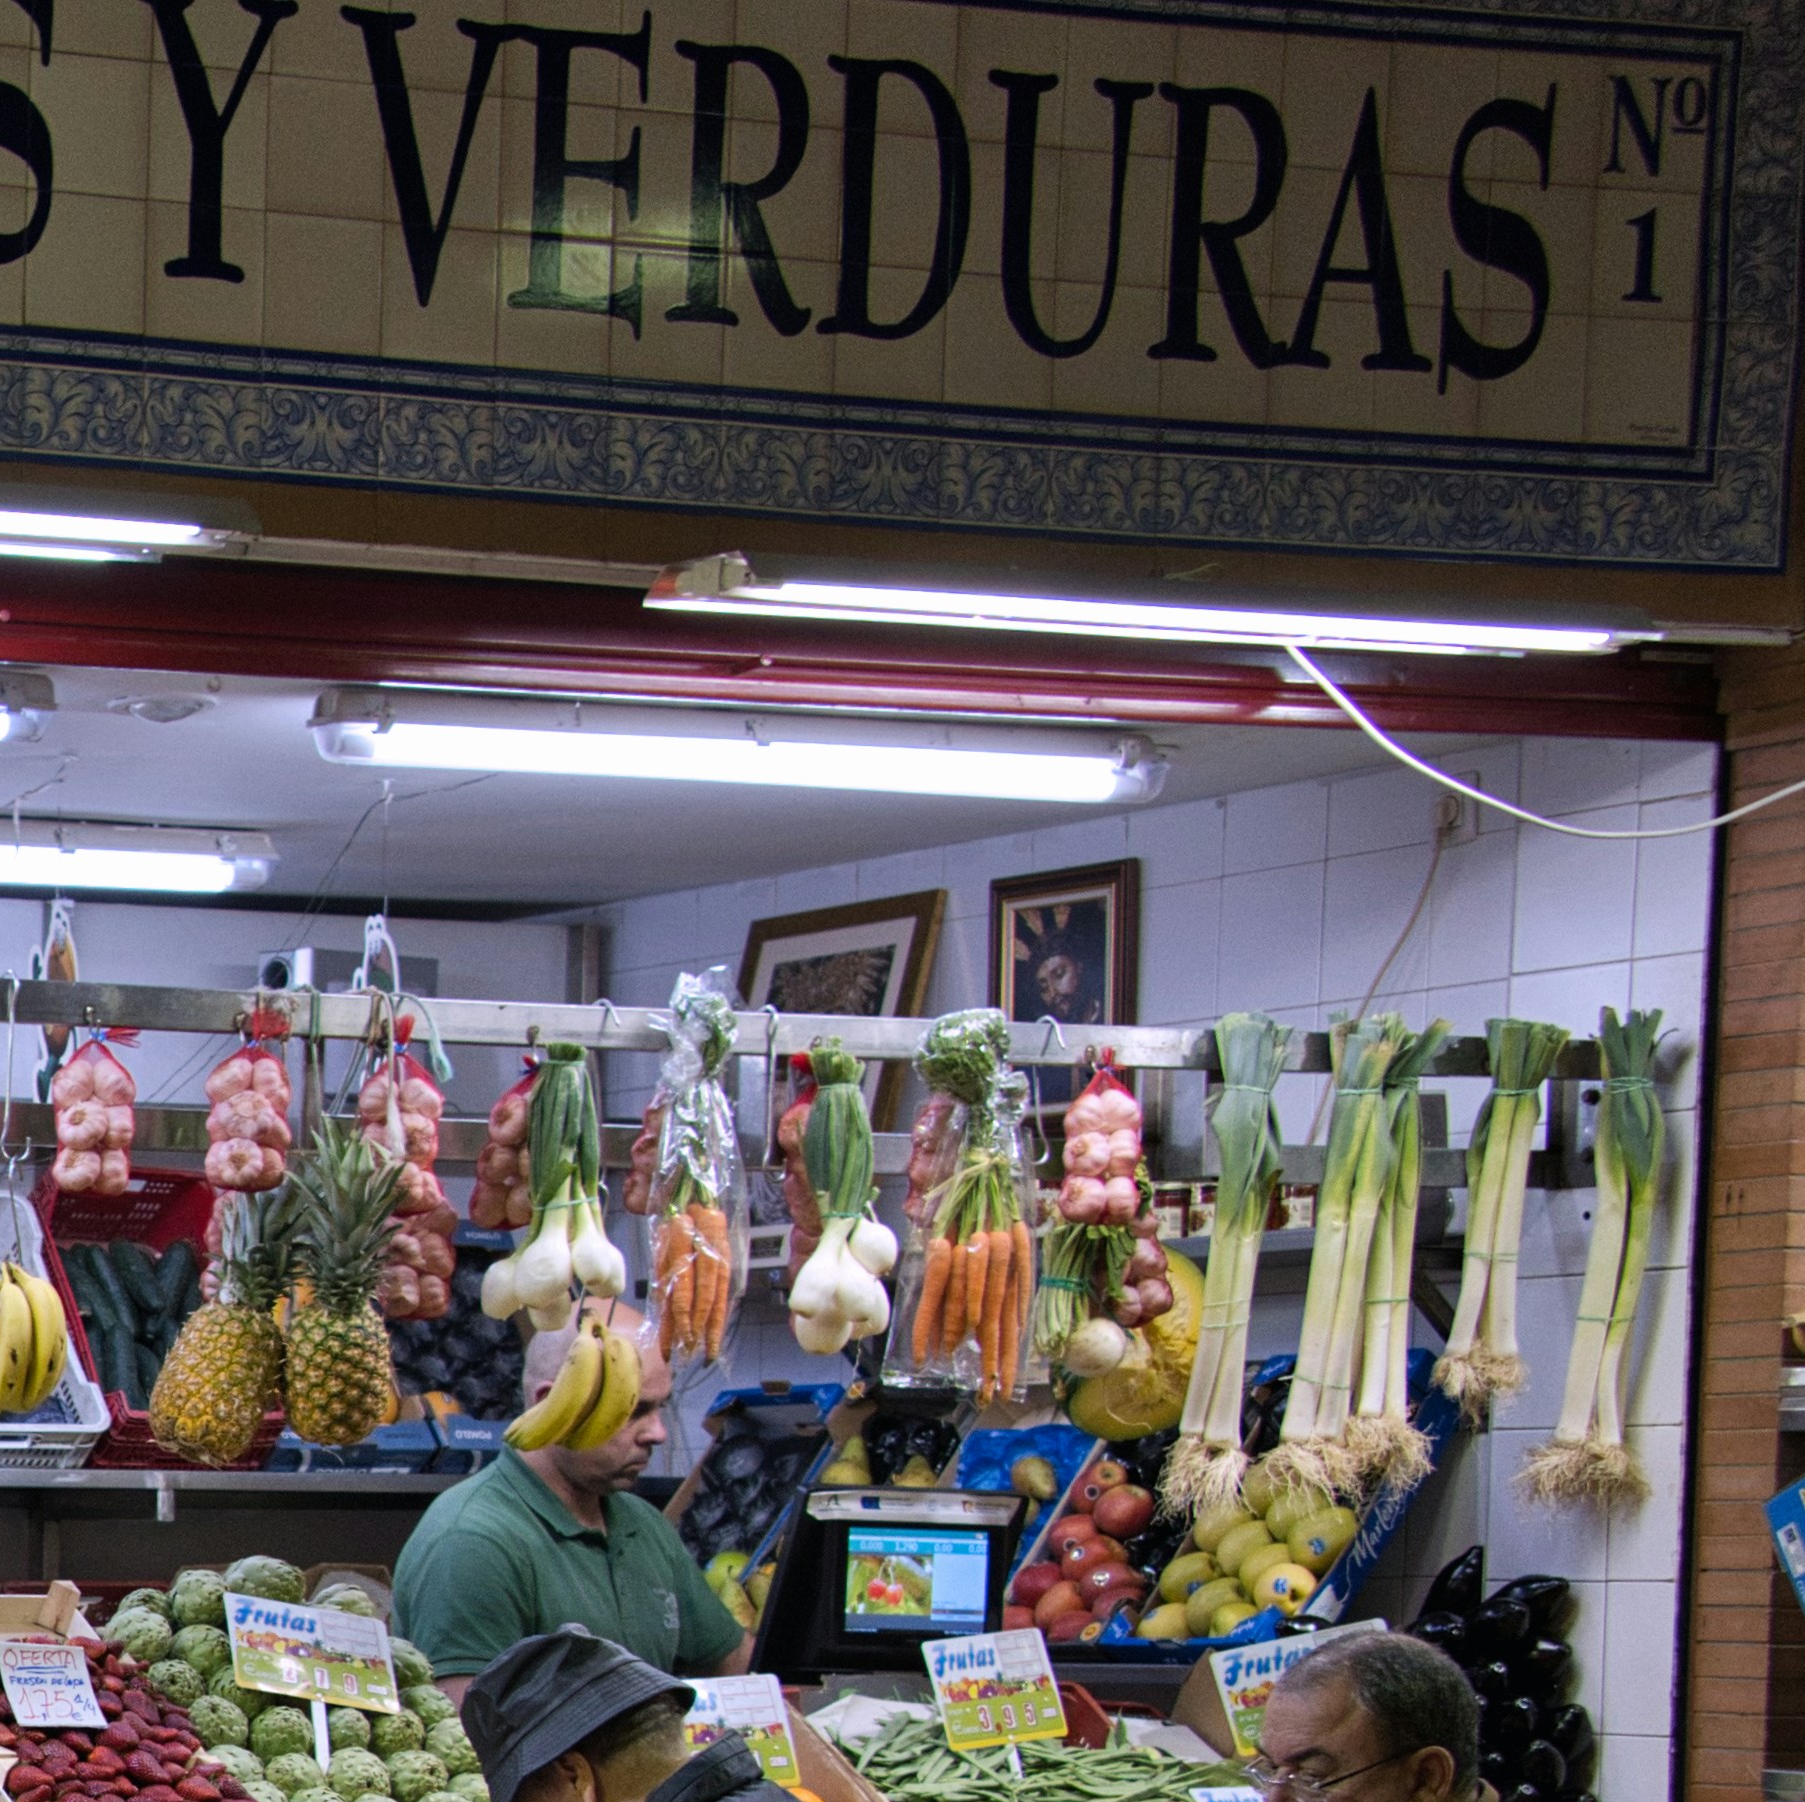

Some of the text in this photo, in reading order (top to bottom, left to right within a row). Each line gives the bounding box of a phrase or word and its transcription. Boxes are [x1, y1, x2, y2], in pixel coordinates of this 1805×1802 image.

[153, 0, 298, 284] Y
[343, 4, 1559, 397] VERDURAS
[1622, 207, 1664, 303] 1
[233, 1598, 318, 1634] Frutas
[2, 1647, 79, 1672] OFERTA
[933, 1643, 996, 1678] Frutas
[18, 1687, 75, 1722] 1,75
